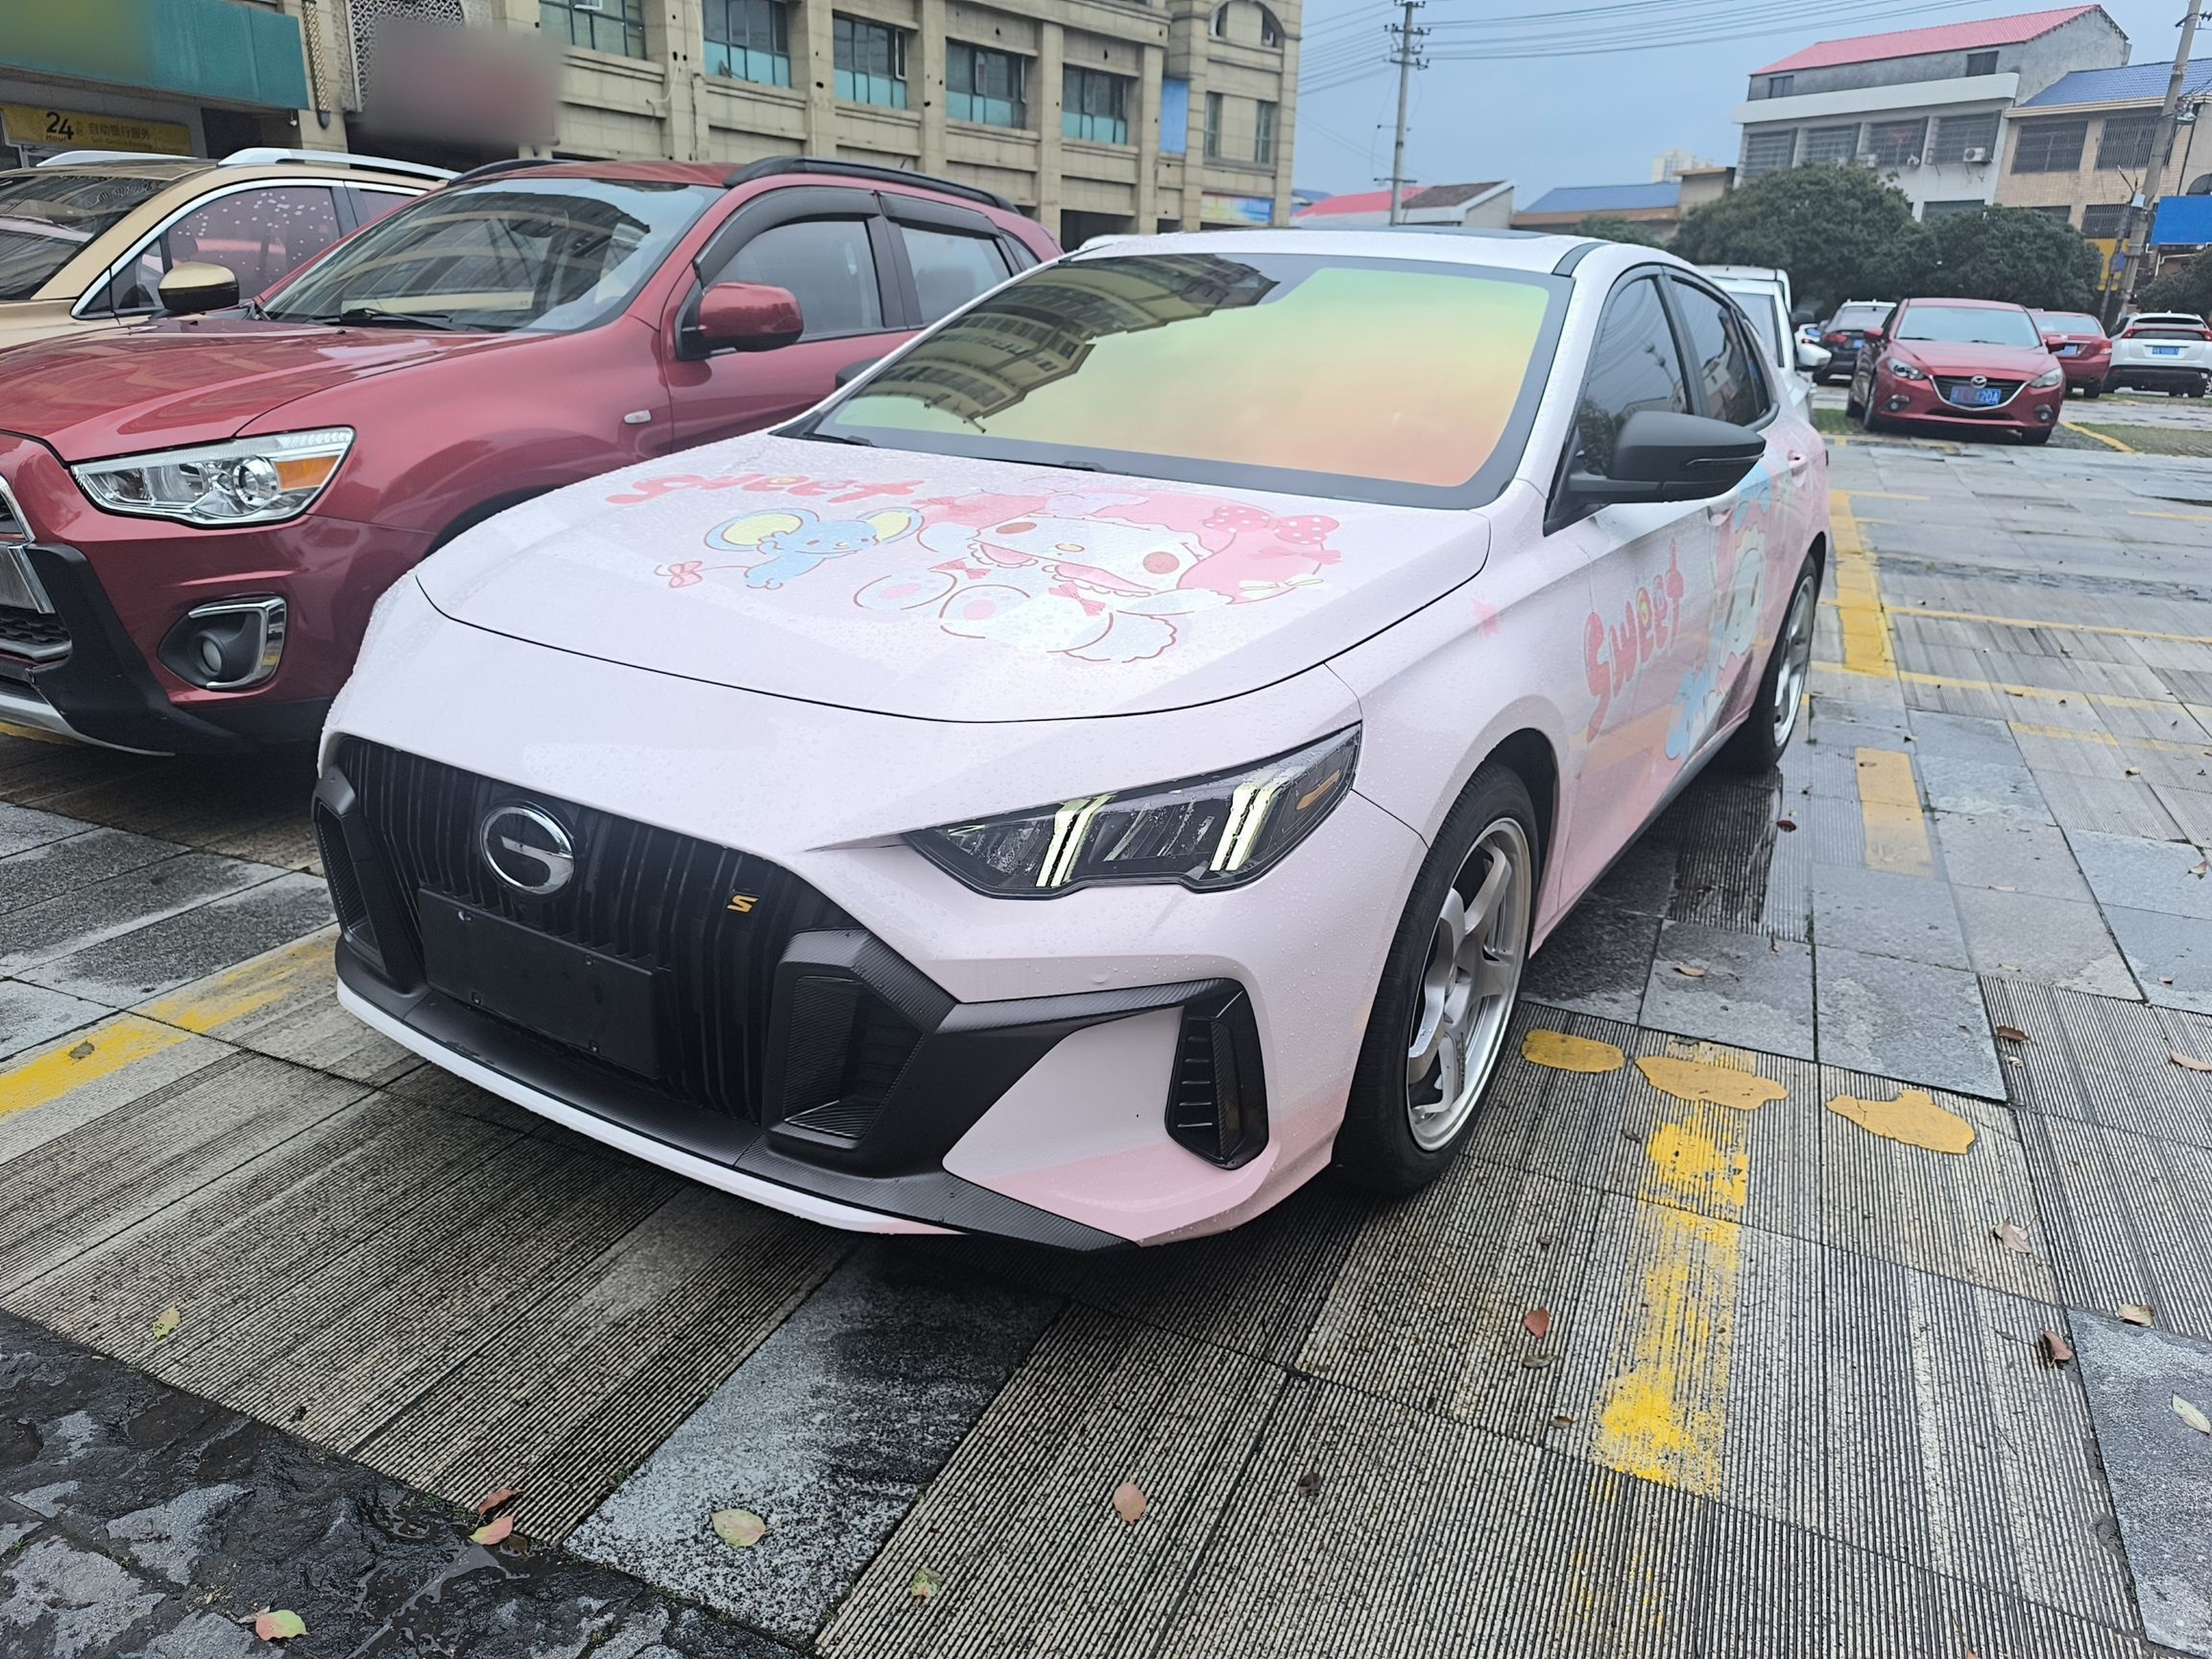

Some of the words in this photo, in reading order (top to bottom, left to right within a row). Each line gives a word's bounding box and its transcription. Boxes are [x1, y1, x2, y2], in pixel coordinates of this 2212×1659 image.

[46, 112, 74, 140] 24
[89, 122, 151, 140] 自助银行服务
[46, 134, 67, 142] Hour
[727, 895, 759, 912] S
